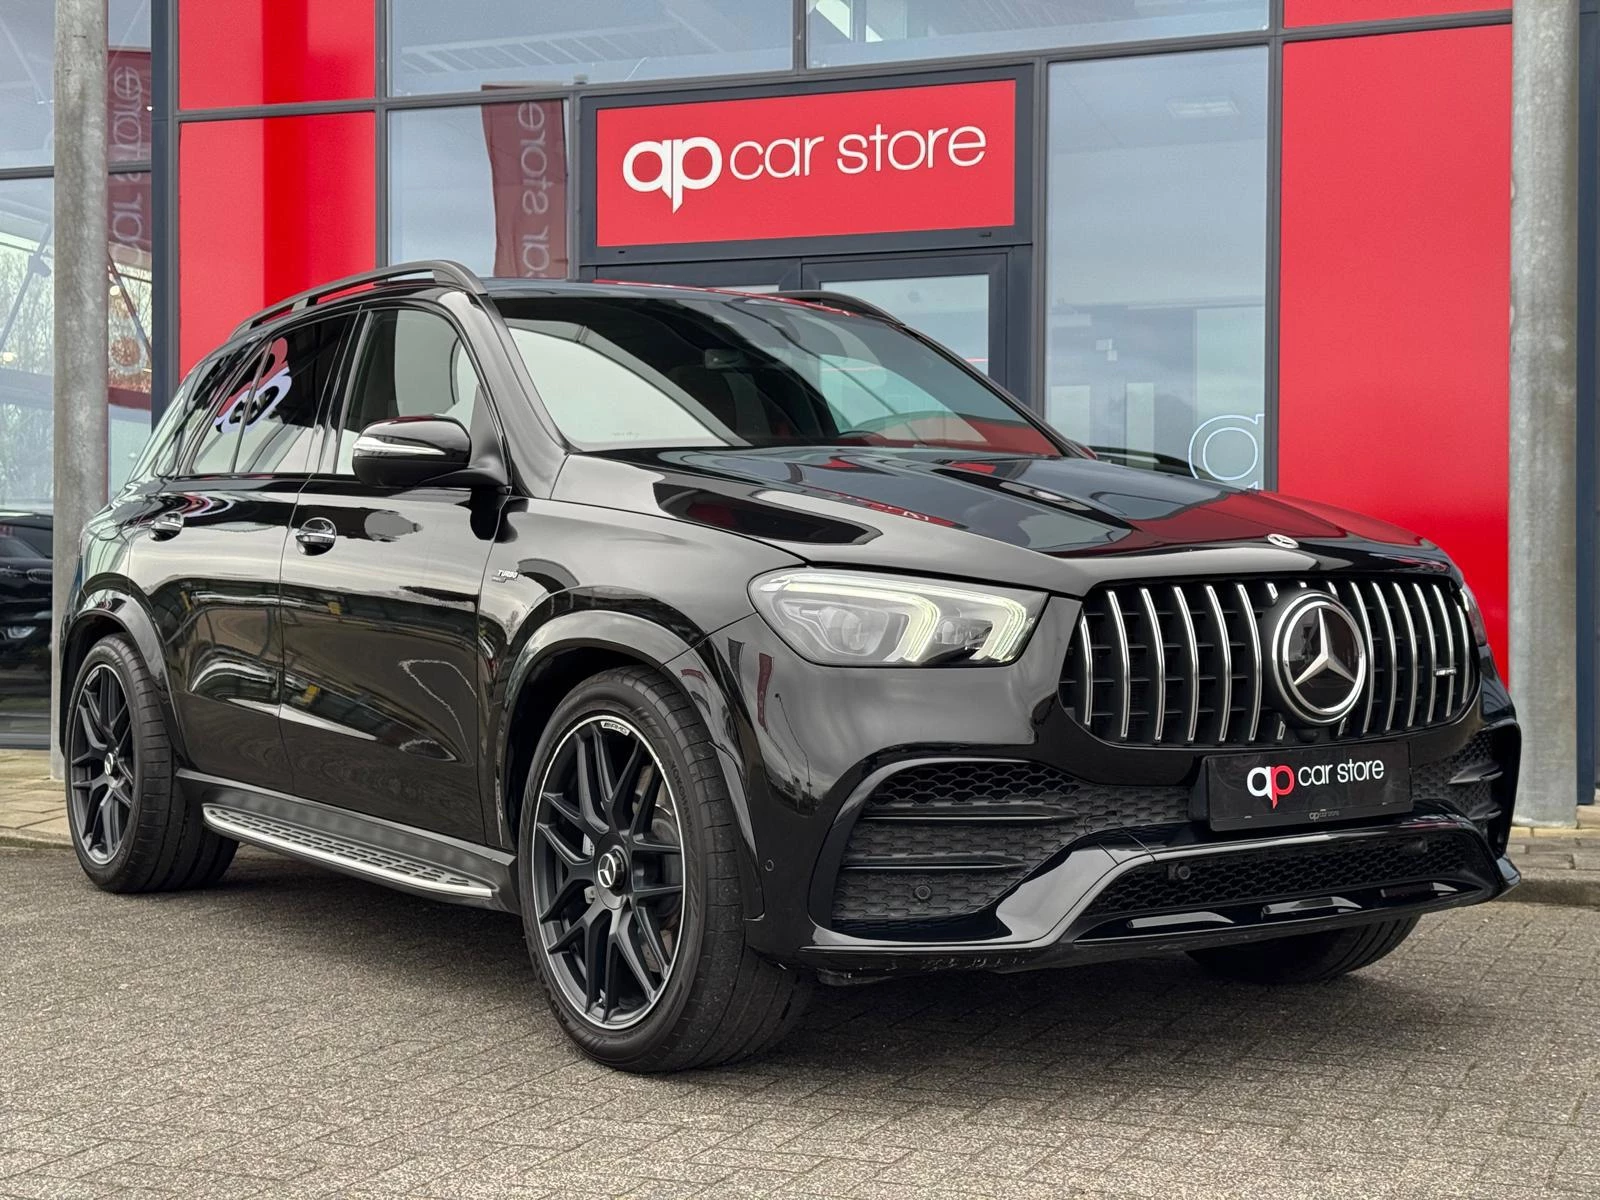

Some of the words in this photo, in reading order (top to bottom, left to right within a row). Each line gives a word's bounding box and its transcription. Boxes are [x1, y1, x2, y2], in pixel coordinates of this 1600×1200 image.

[622, 136, 723, 214] ap
[729, 135, 825, 181] car
[836, 123, 987, 175] store
[1246, 764, 1295, 809] ap
[1298, 764, 1333, 787] car
[1337, 758, 1384, 783] store
